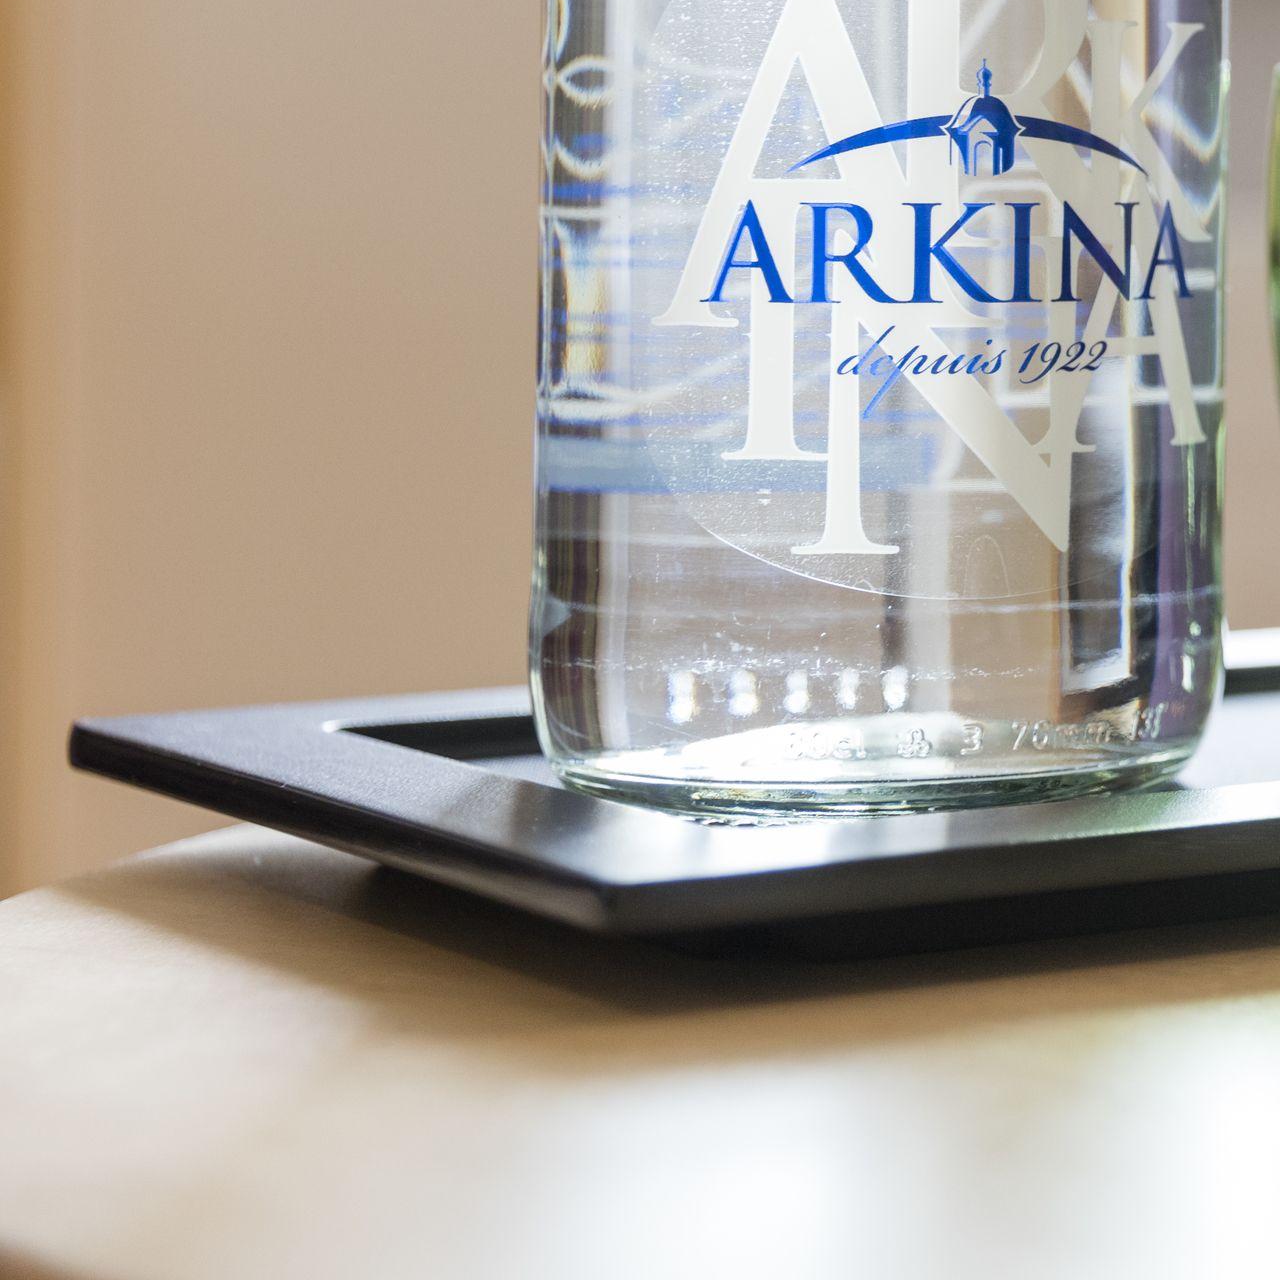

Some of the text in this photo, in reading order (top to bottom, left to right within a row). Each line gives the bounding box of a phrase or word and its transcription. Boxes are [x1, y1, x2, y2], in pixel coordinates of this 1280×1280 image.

[699, 198, 1195, 304] ARKINA
[837, 325, 1108, 420] depuis 1922
